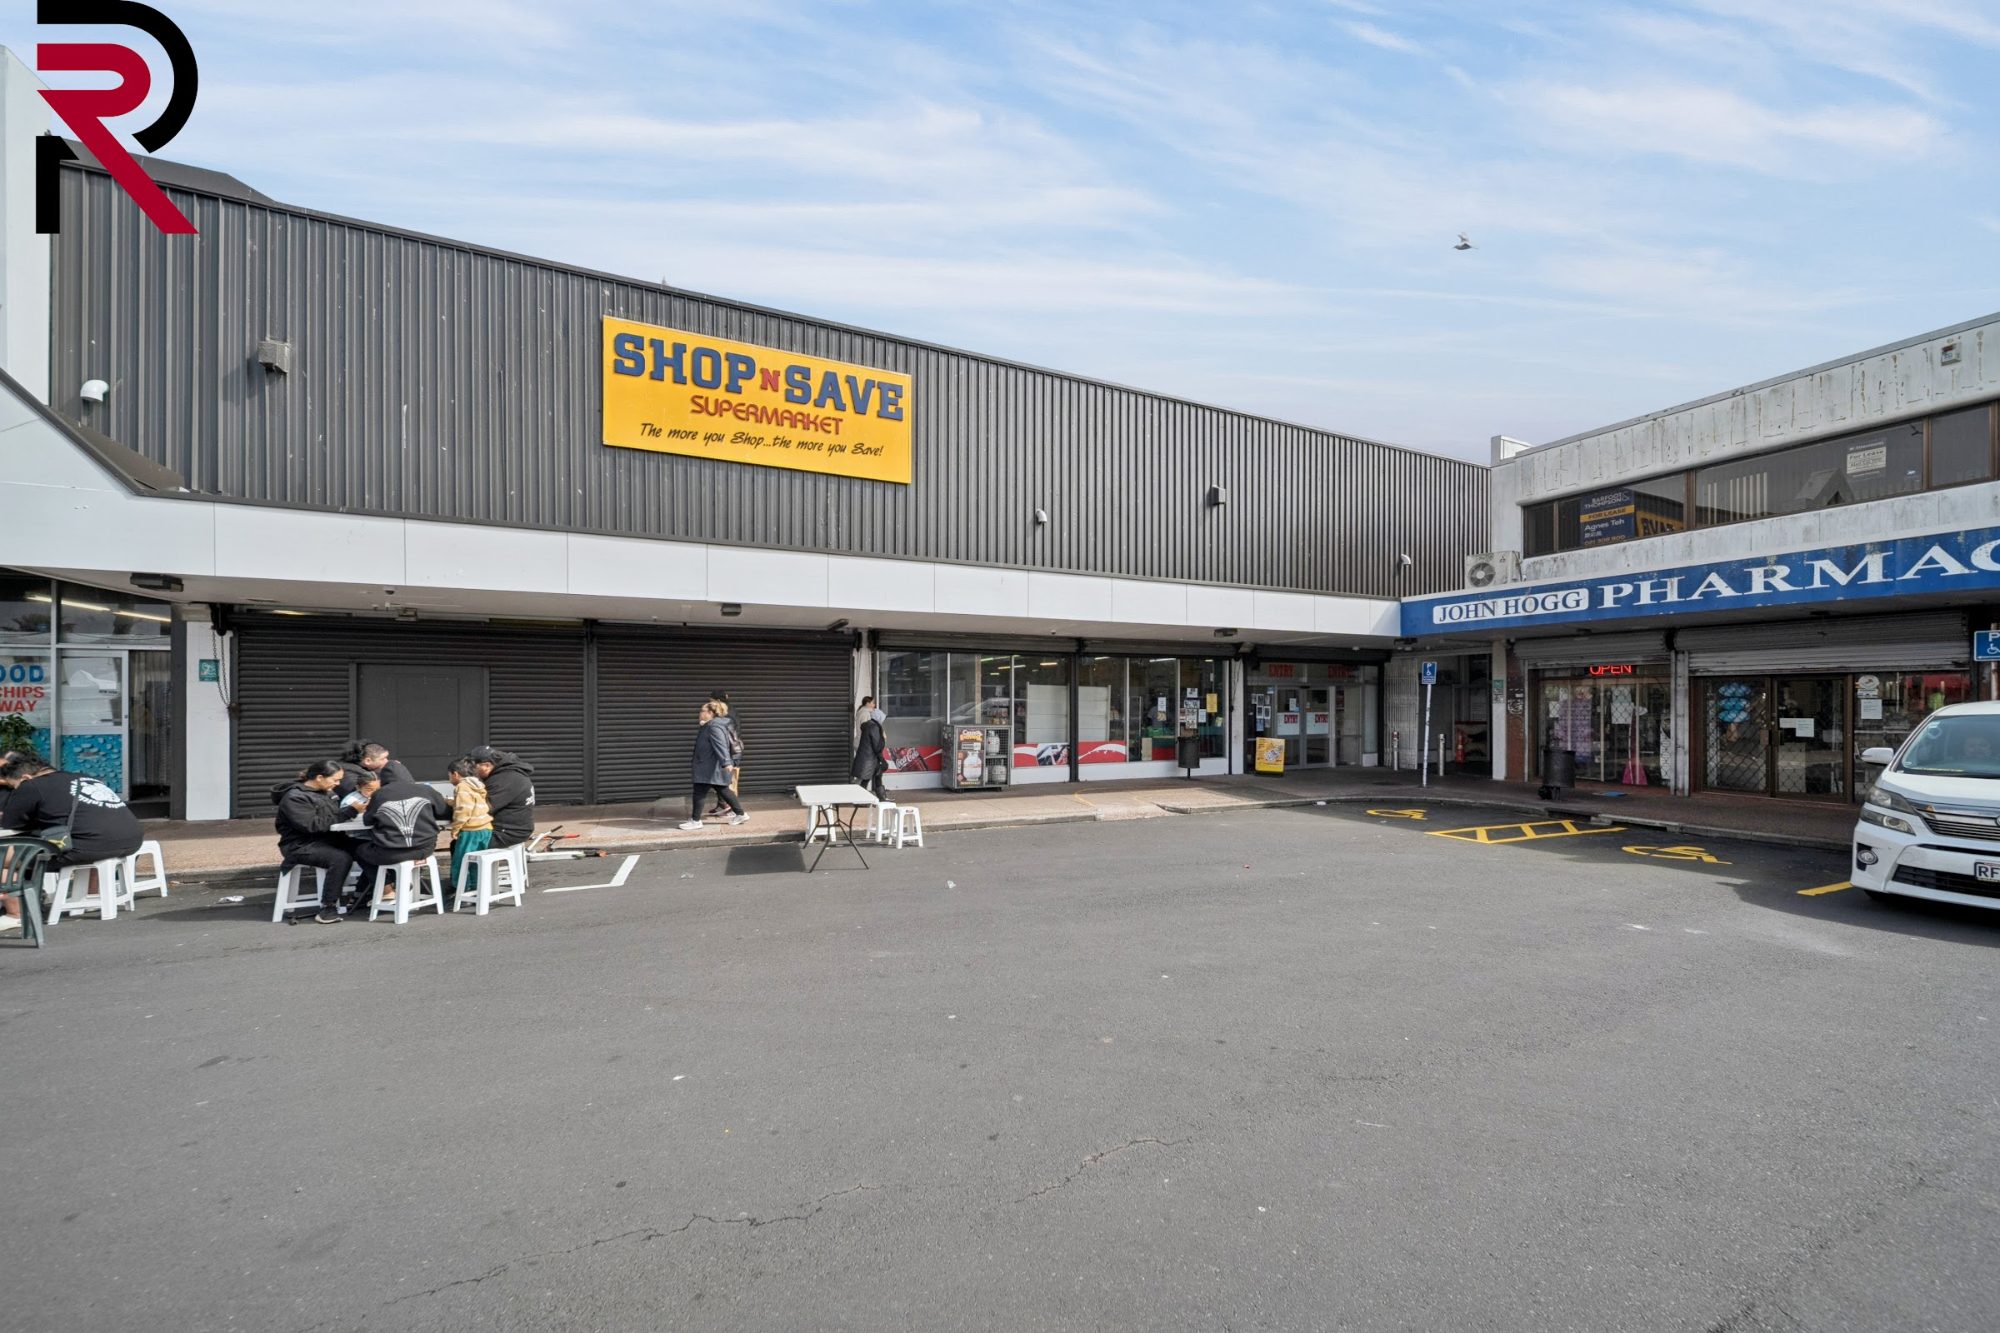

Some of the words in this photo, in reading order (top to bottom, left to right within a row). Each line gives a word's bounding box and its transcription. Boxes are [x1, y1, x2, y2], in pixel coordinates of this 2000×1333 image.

[614, 332, 756, 394] SHOP
[759, 367, 781, 392] N
[785, 364, 904, 421] SAVE
[690, 394, 843, 436] SUPERMARKET
[641, 423, 662, 438] The
[667, 428, 698, 440] more
[703, 430, 725, 446] you
[796, 440, 824, 452] more
[828, 443, 847, 457] you
[851, 441, 884, 457] Save!
[1584, 521, 1610, 532] Agnes
[1438, 601, 1497, 622] JOHN
[1503, 591, 1584, 616] HOGG
[1589, 664, 1632, 676] OPEN
[1978, 866, 2000, 878] RF
